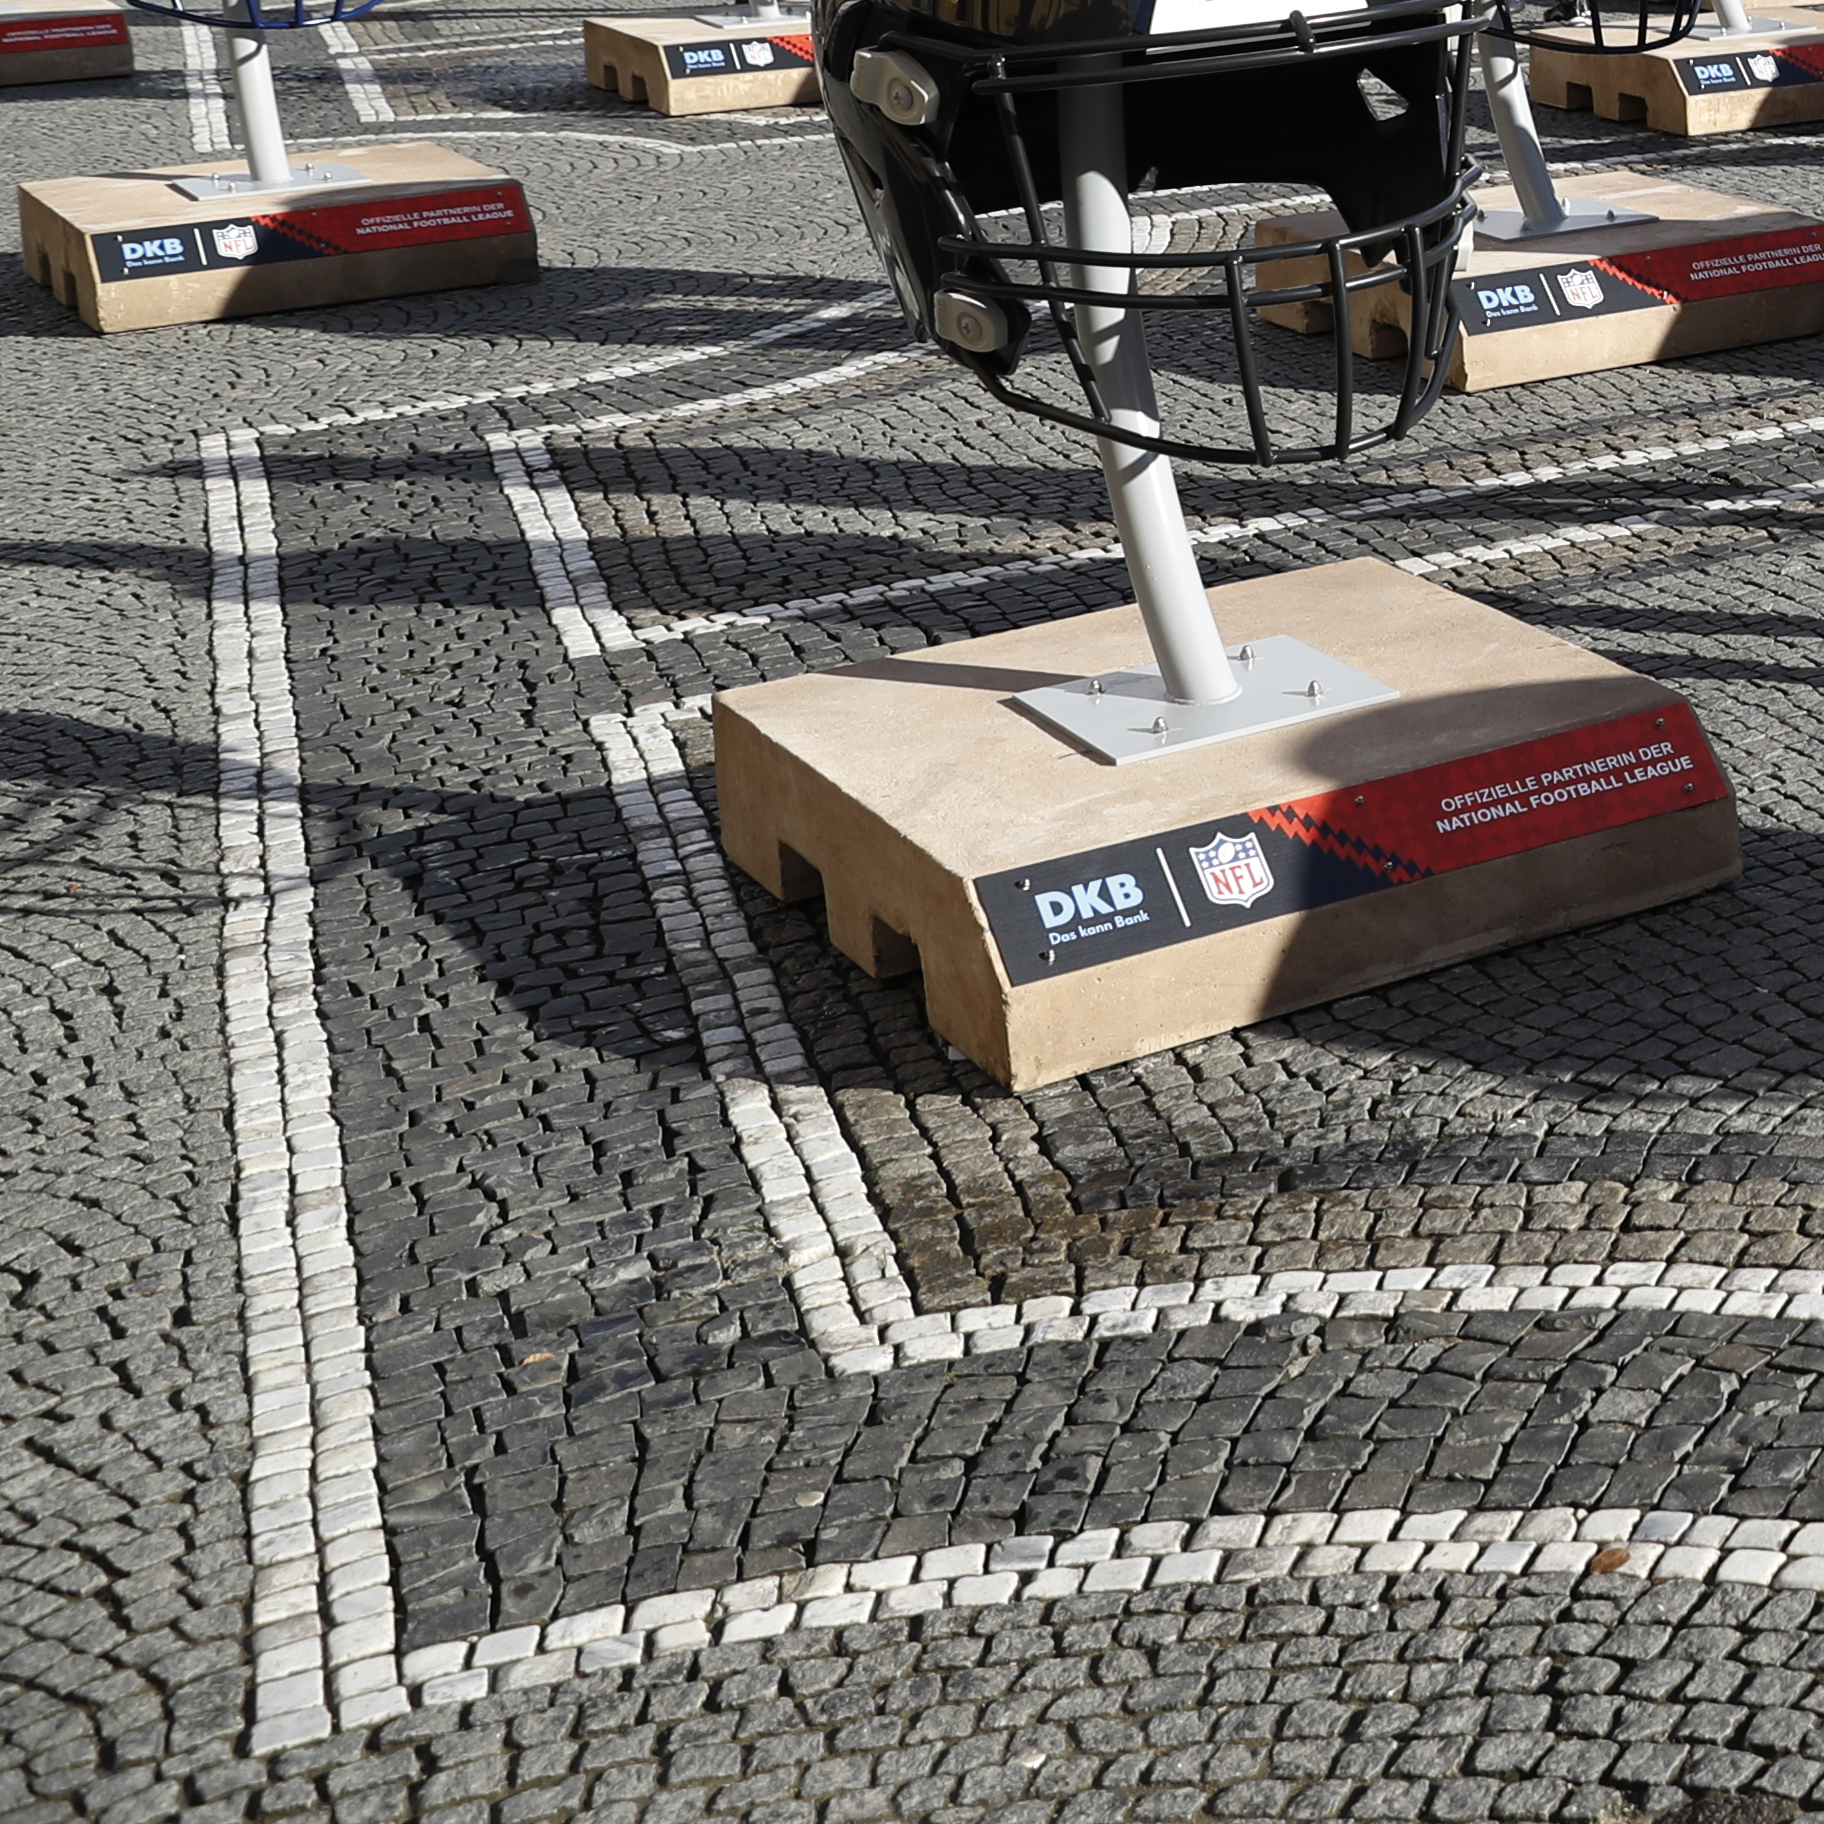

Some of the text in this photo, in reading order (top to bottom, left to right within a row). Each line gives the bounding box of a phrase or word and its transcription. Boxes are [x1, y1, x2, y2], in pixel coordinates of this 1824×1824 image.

[683, 49, 724, 64] DKB
[1694, 63, 1734, 79] DKB
[356, 210, 515, 235] NATIONAL FOOTBALL LEAGUE
[361, 202, 504, 226] OFFIZIELLE PARTNERIN DER
[122, 238, 184, 260] DKB
[222, 238, 254, 253] NFL
[1692, 243, 1822, 270] OFFIZIELLE PARTNERIN DER
[1690, 267, 1740, 281] NATIONAL
[1741, 258, 1793, 273] FOOTBALL
[1477, 285, 1535, 309] DKB
[1570, 285, 1598, 303] NFL
[1441, 741, 1675, 812] OFFIZIELLE PARTNERIN DER
[1436, 756, 1695, 834] NATIONAL FOOTBALL LEAGUE
[1210, 860, 1265, 895] NFL
[1034, 873, 1144, 929] DKB
[1048, 910, 1150, 946] Das kann Bank
